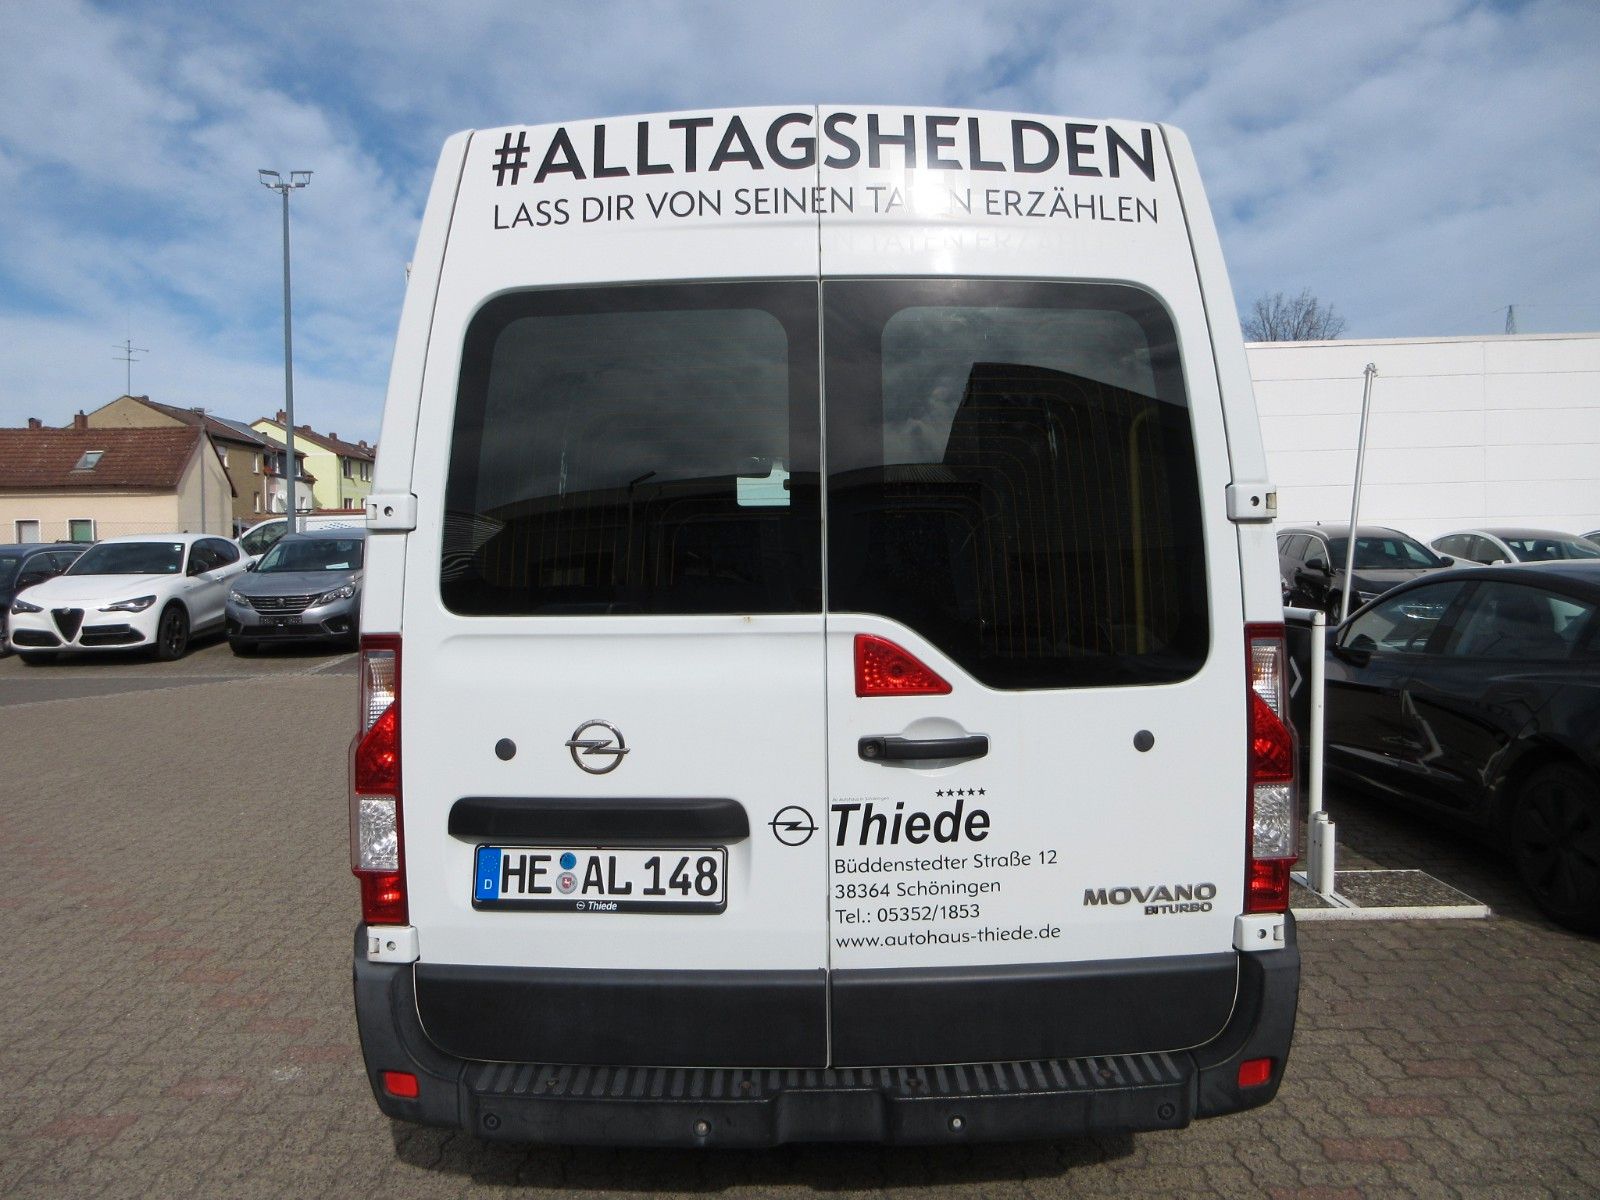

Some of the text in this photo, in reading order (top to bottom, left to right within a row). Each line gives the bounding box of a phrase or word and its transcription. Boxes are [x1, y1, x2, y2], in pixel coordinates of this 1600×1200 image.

[492, 112, 1156, 187] #ALLTAGSHELDEN
[494, 186, 1159, 230] LASS DIR VON SEINEN TAN ERZÄHLEN
[830, 799, 991, 847] Thiede
[834, 849, 1058, 874] Büddenstedter Straße 12
[483, 878, 493, 890] D
[501, 854, 718, 896] HE AL 148
[834, 880, 1001, 900] 38364 Schöningen
[1083, 882, 1217, 906] MOVANO
[587, 900, 618, 912] Thiede
[835, 903, 981, 924] Tel.: 05352/1853
[1144, 902, 1213, 915] BITURBO
[835, 923, 1061, 948] www.autohaus-thiede.de
